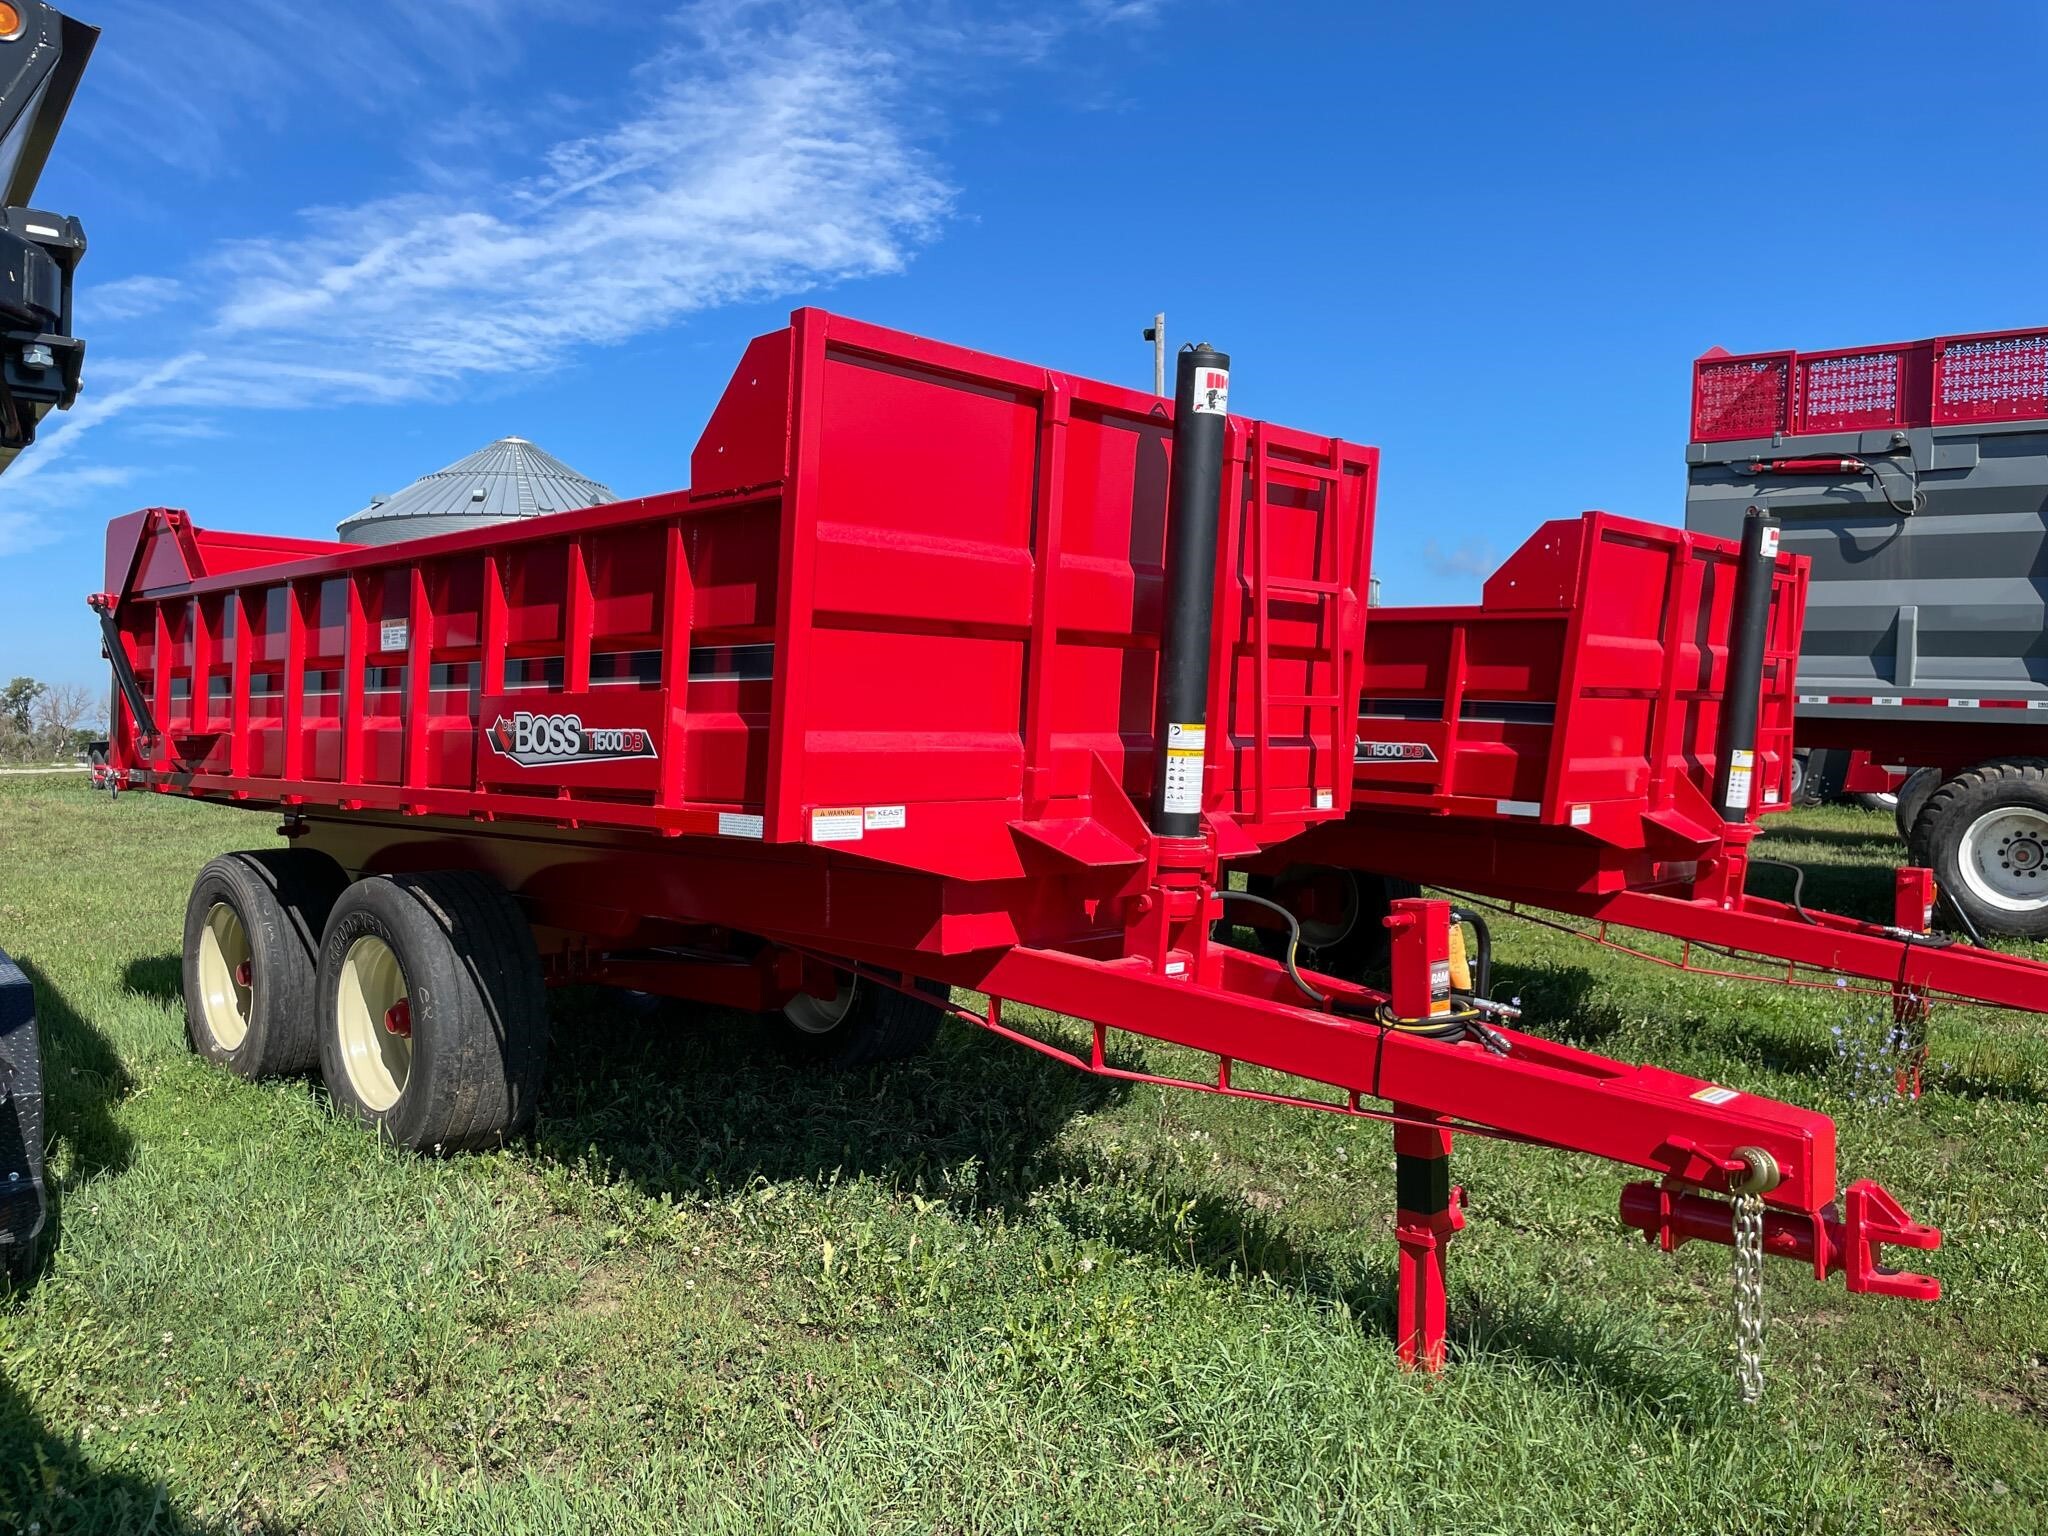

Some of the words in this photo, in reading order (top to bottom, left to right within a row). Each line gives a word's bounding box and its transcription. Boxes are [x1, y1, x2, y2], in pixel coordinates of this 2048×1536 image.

[515, 714, 581, 755] BOSS
[585, 731, 644, 752] T1500DB
[1364, 744, 1425, 758] T1500DB
[827, 809, 856, 817] WARNING
[877, 808, 904, 817] KEAST
